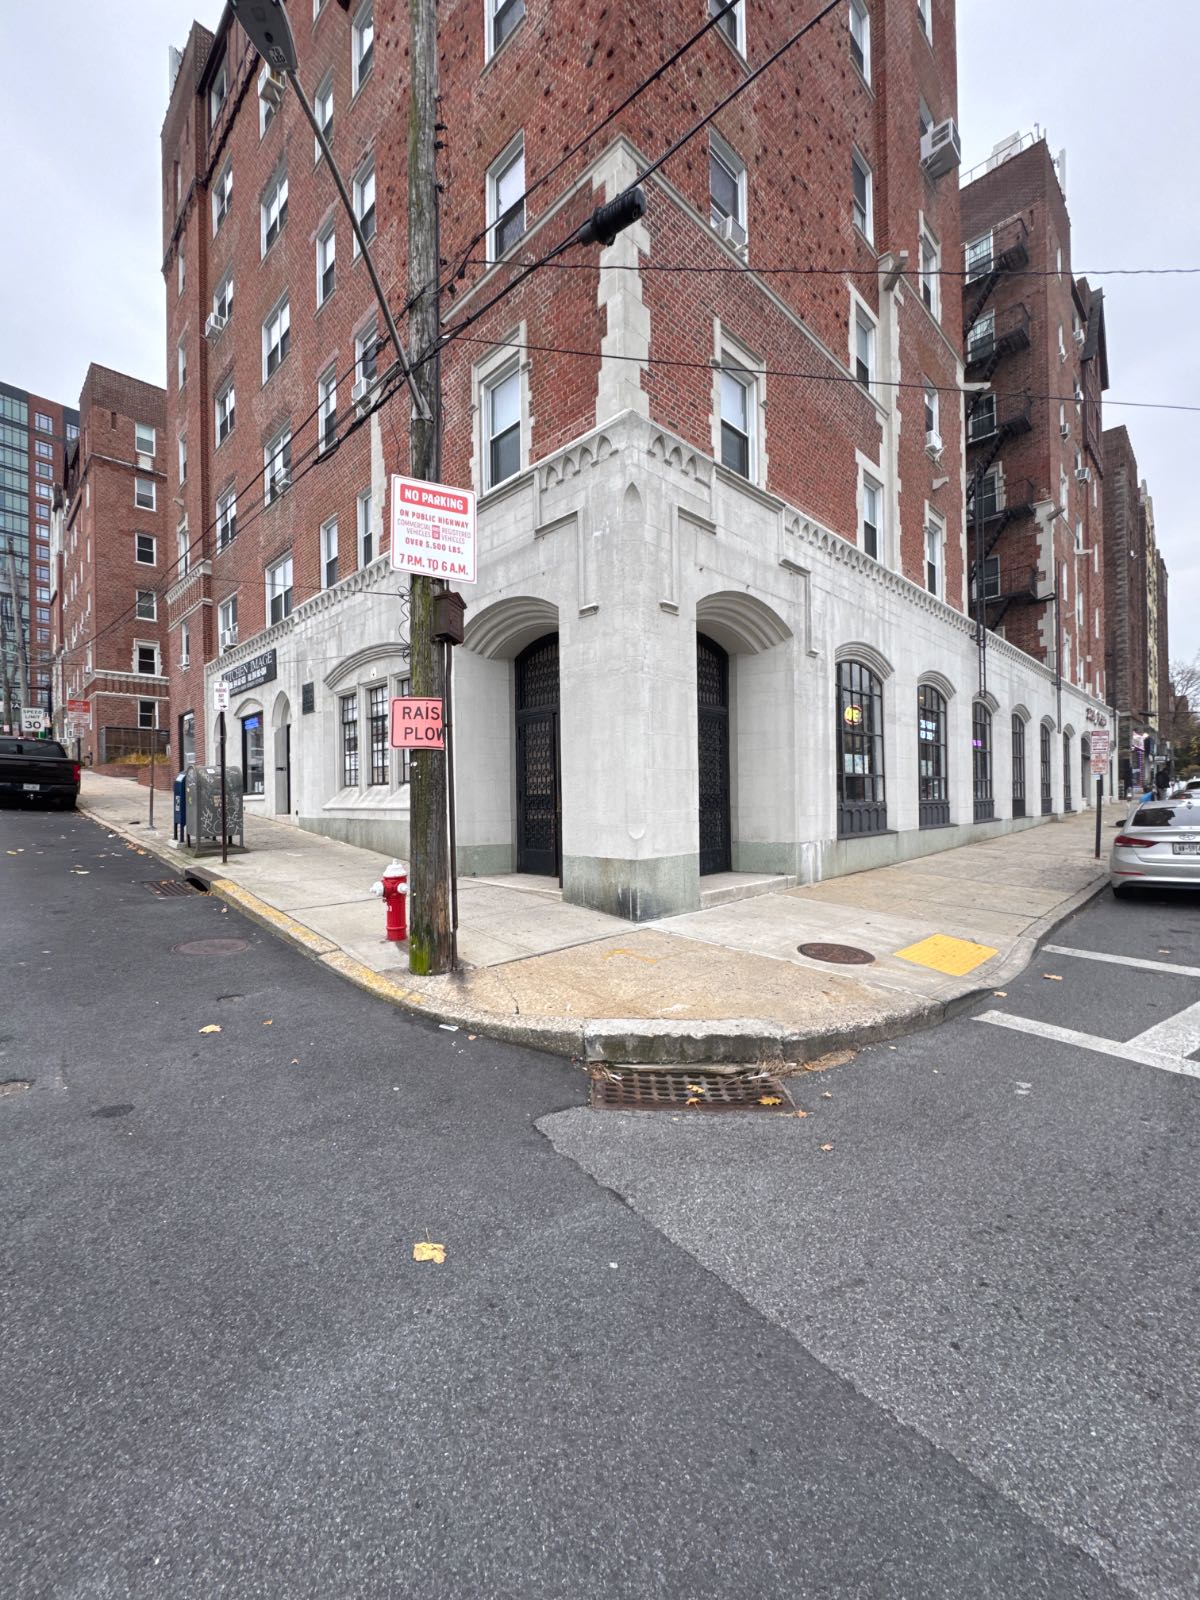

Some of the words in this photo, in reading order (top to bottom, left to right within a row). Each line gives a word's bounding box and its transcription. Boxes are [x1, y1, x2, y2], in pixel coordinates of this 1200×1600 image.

[404, 488, 418, 501] NO
[422, 493, 463, 510] PARKING
[397, 518, 431, 530] COMMERCIAL
[399, 508, 410, 517] ON
[412, 510, 436, 522] PUBLIC
[438, 517, 469, 529] HIGHWAY
[406, 527, 431, 538] VEHICLES
[441, 527, 471, 539] REGISTERED
[441, 534, 465, 545] VEHICLES
[405, 537, 423, 547] OVER
[448, 545, 464, 555] LBS.
[399, 553, 405, 563] 7
[407, 554, 425, 568] P.M.
[427, 558, 439, 571] TO
[441, 561, 448, 572] 6
[449, 562, 469, 575] A.M.
[250, 652, 273, 670] IMAGE
[402, 706, 442, 720] RAIS
[25, 720, 42, 729] 30
